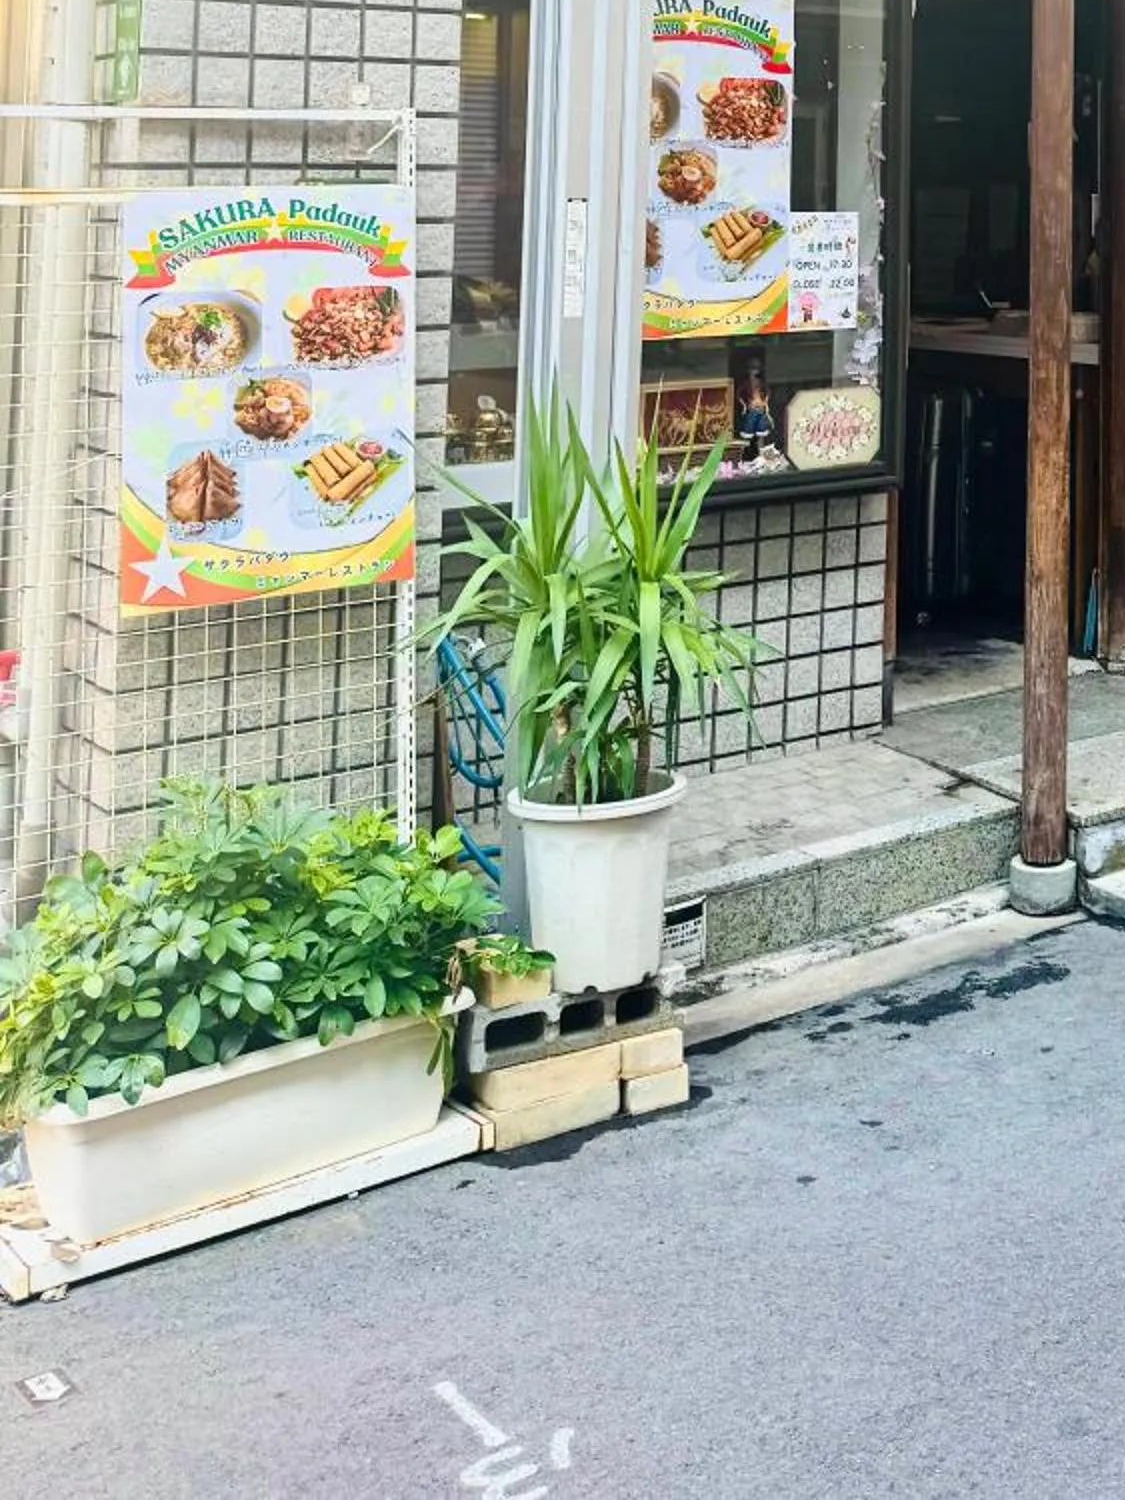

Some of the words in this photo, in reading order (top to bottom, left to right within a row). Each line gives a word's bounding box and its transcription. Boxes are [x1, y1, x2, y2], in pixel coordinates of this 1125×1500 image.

[703, 0, 771, 38] Padauk
[159, 197, 275, 250] SAKURA
[289, 198, 381, 238] Padauk
